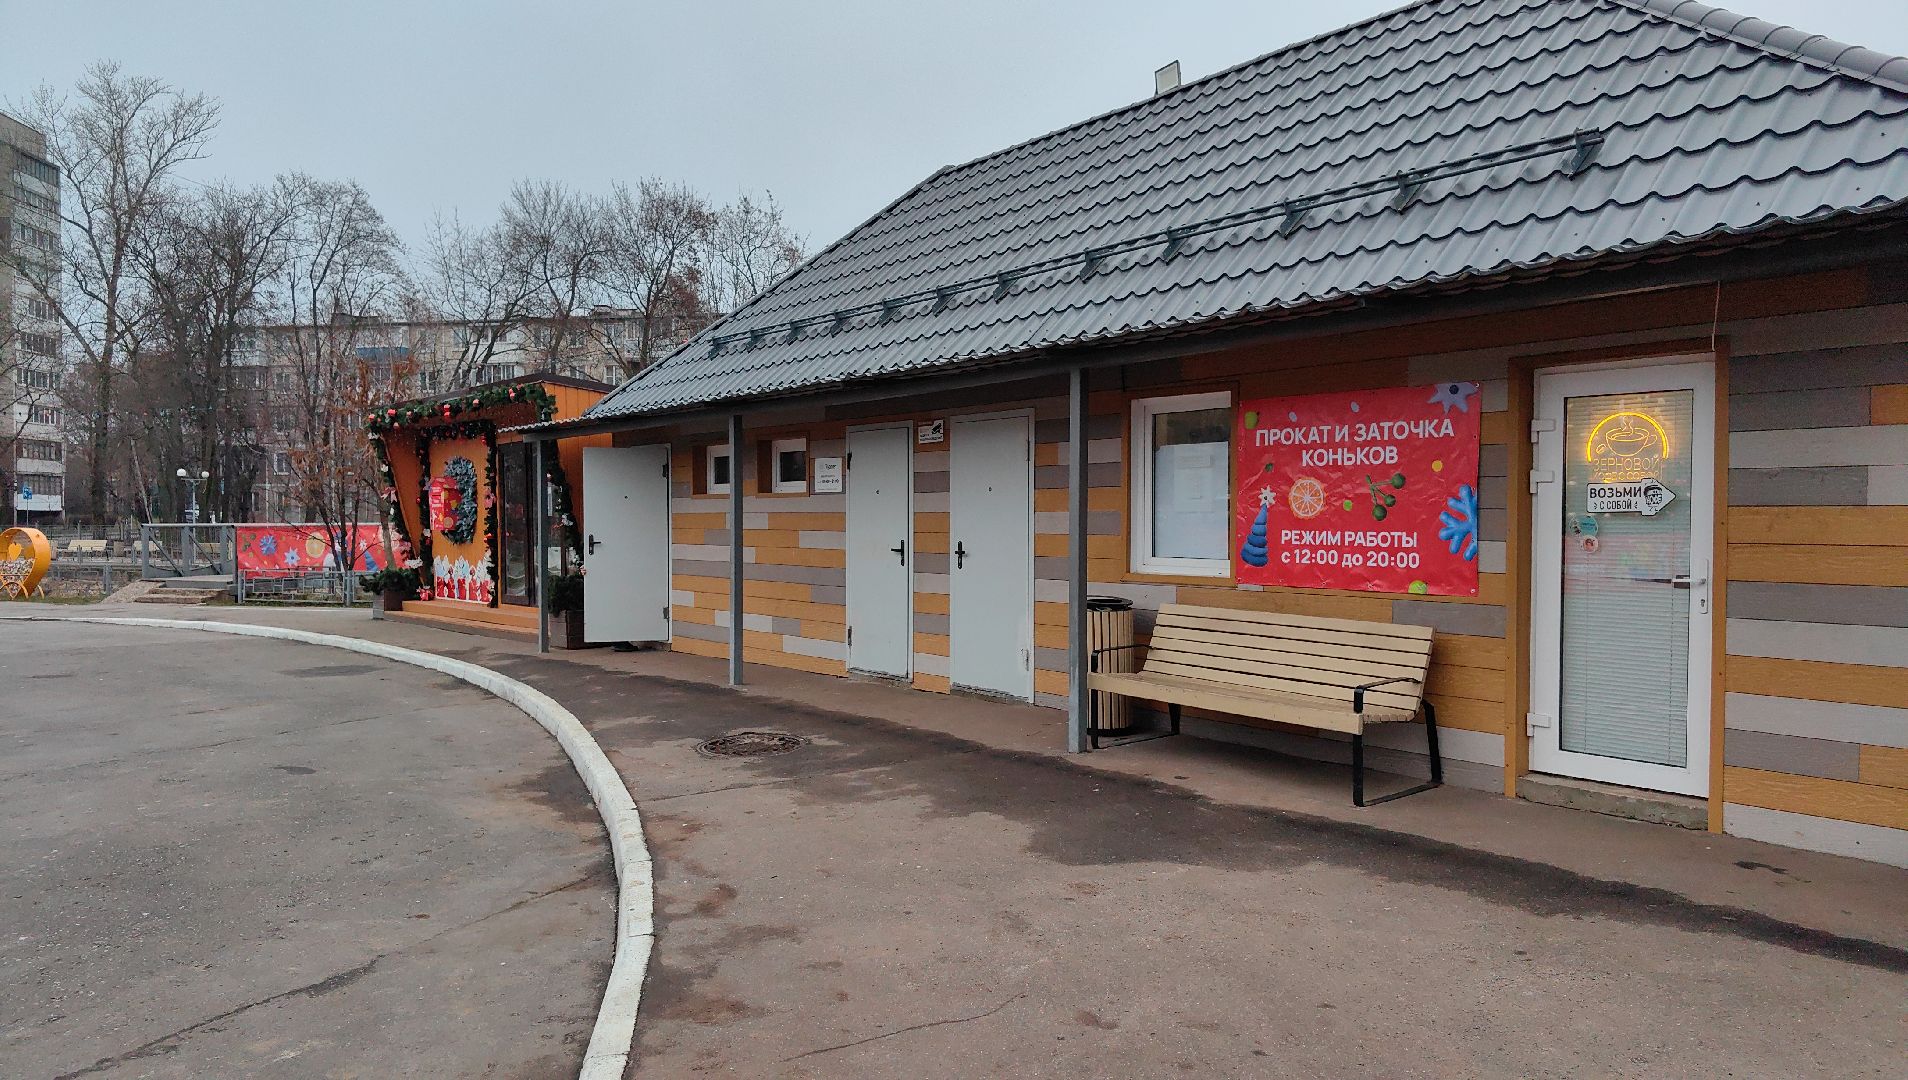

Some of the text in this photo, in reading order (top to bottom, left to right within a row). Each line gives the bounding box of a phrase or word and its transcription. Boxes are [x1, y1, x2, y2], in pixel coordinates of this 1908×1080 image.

[1256, 418, 1455, 447] ПРОКАТ И ЗАТОЧКА
[1301, 445, 1399, 467] КОНЬКОВ
[1593, 455, 1660, 471] ЗЕРНОВОЙ
[1590, 487, 1641, 498] ВОЗЬМИ
[1599, 498, 1632, 510] С СОБОЙ
[1281, 529, 1417, 548] РЕЖИМ РАБОТЫ
[1281, 549, 1420, 569] с 12:00 до 20:00
